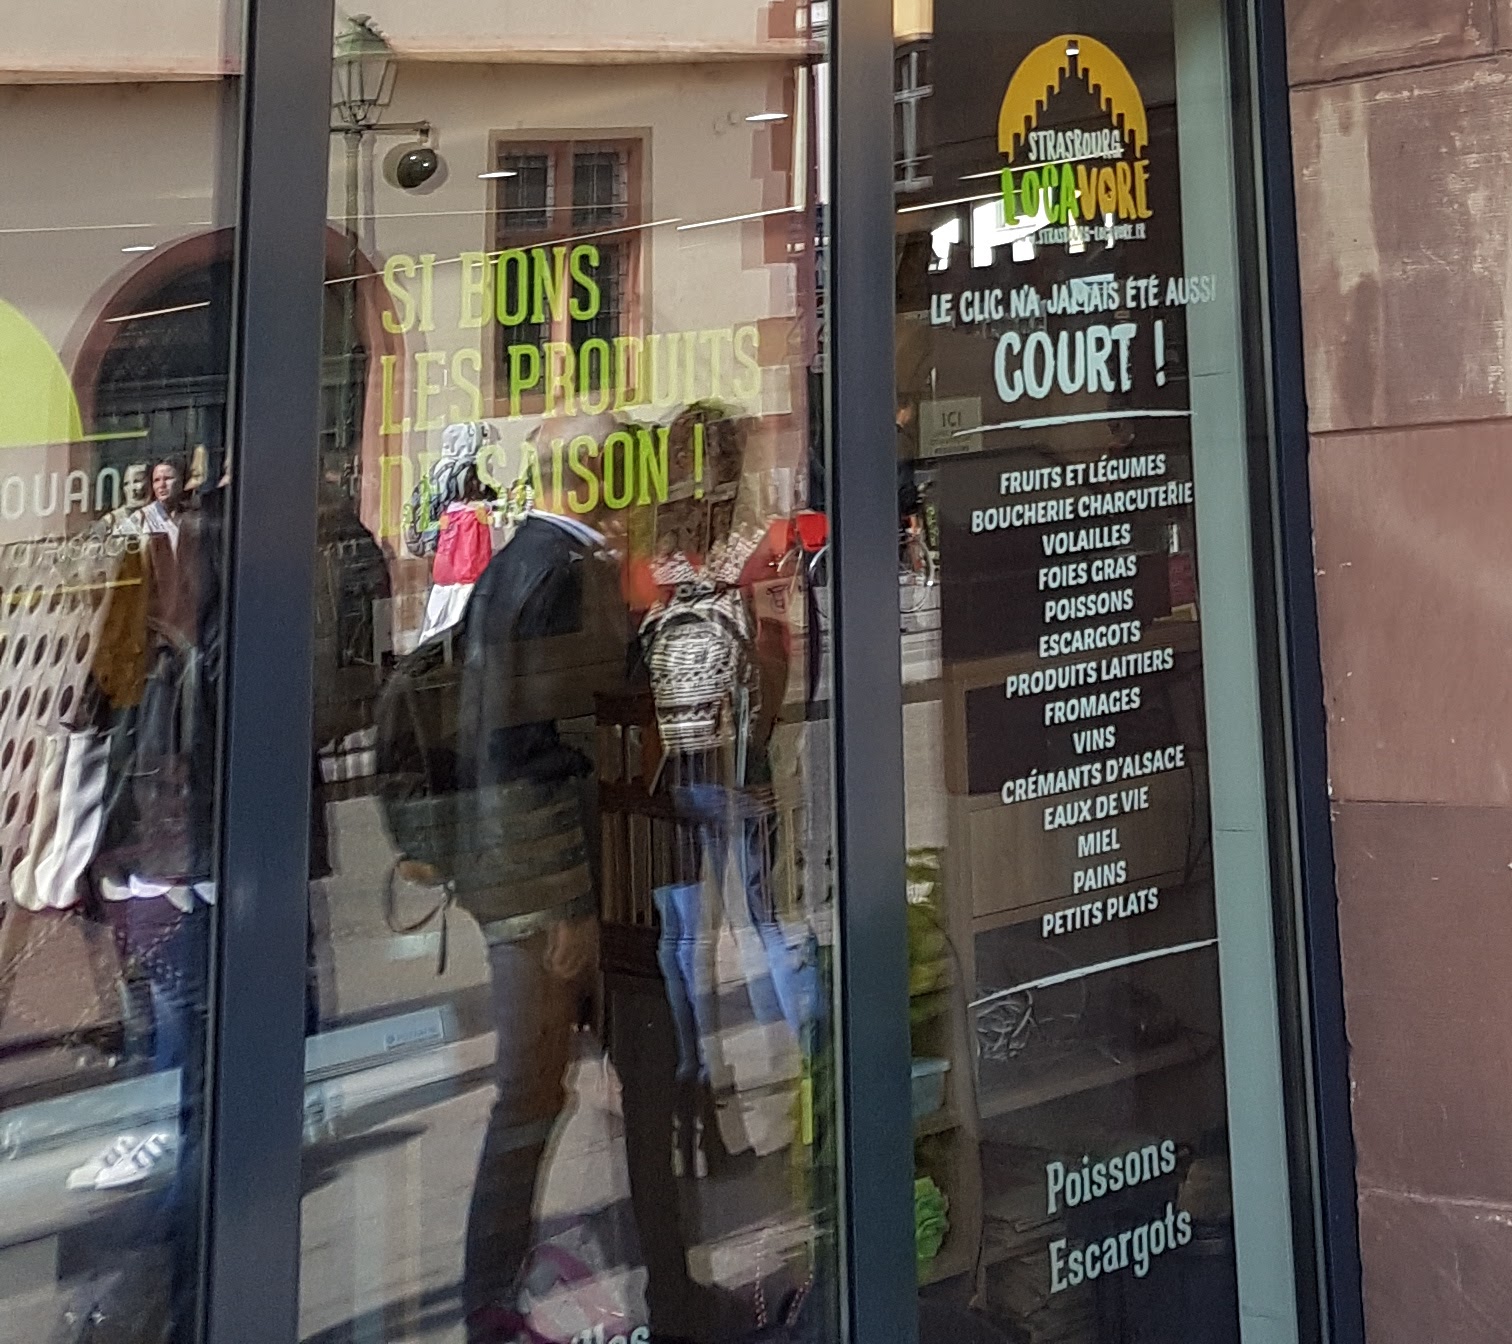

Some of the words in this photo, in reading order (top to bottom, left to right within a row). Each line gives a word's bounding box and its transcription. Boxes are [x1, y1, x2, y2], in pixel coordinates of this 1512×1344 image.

[1028, 128, 1125, 161] STRASBOURG
[1001, 158, 1153, 226] LOCAVORE
[382, 249, 435, 334] SI
[460, 244, 602, 330] BONS
[931, 293, 953, 325] LE
[960, 287, 1004, 323] CLIC
[1047, 277, 1120, 315] JAMAIS
[1126, 273, 1160, 308] ÉTÉ
[1166, 273, 1217, 307] AUSSI
[380, 346, 484, 436] LES
[509, 326, 762, 421] PRODUITS
[994, 323, 1138, 404] COURT
[942, 411, 961, 427] ICI
[476, 425, 670, 514] SAISON
[1001, 468, 1061, 496] FRUITS
[1065, 463, 1087, 487] ET
[1089, 453, 1166, 484] LÉGUMES
[971, 499, 1074, 533] BOUCHERIE
[1078, 482, 1194, 518] CHARCUTERIE
[1042, 523, 1131, 556] VOLAILLES
[1039, 561, 1088, 591] FOIES
[1092, 555, 1137, 582] GRAS
[1044, 589, 1134, 623] POISSONS
[1039, 620, 1141, 658] ESCARGOTS
[1006, 662, 1098, 699] PRODUITS
[1101, 648, 1174, 683] LAITIERS
[1044, 687, 1141, 727] FROMAGES
[1073, 726, 1116, 755] VINS
[1002, 763, 1101, 805] CRÉMANTS
[1105, 744, 1185, 784] D'ALSACE
[1043, 802, 1091, 831] EAUX
[1095, 795, 1119, 819] DE
[1120, 785, 1149, 812] VIE
[1078, 829, 1120, 858] MIEL
[1073, 861, 1126, 895] PAINS
[1042, 903, 1103, 938] PETITS
[1107, 887, 1159, 924] PLATS
[1046, 1139, 1177, 1216] Poissons
[1049, 1201, 1193, 1294] Escargots
